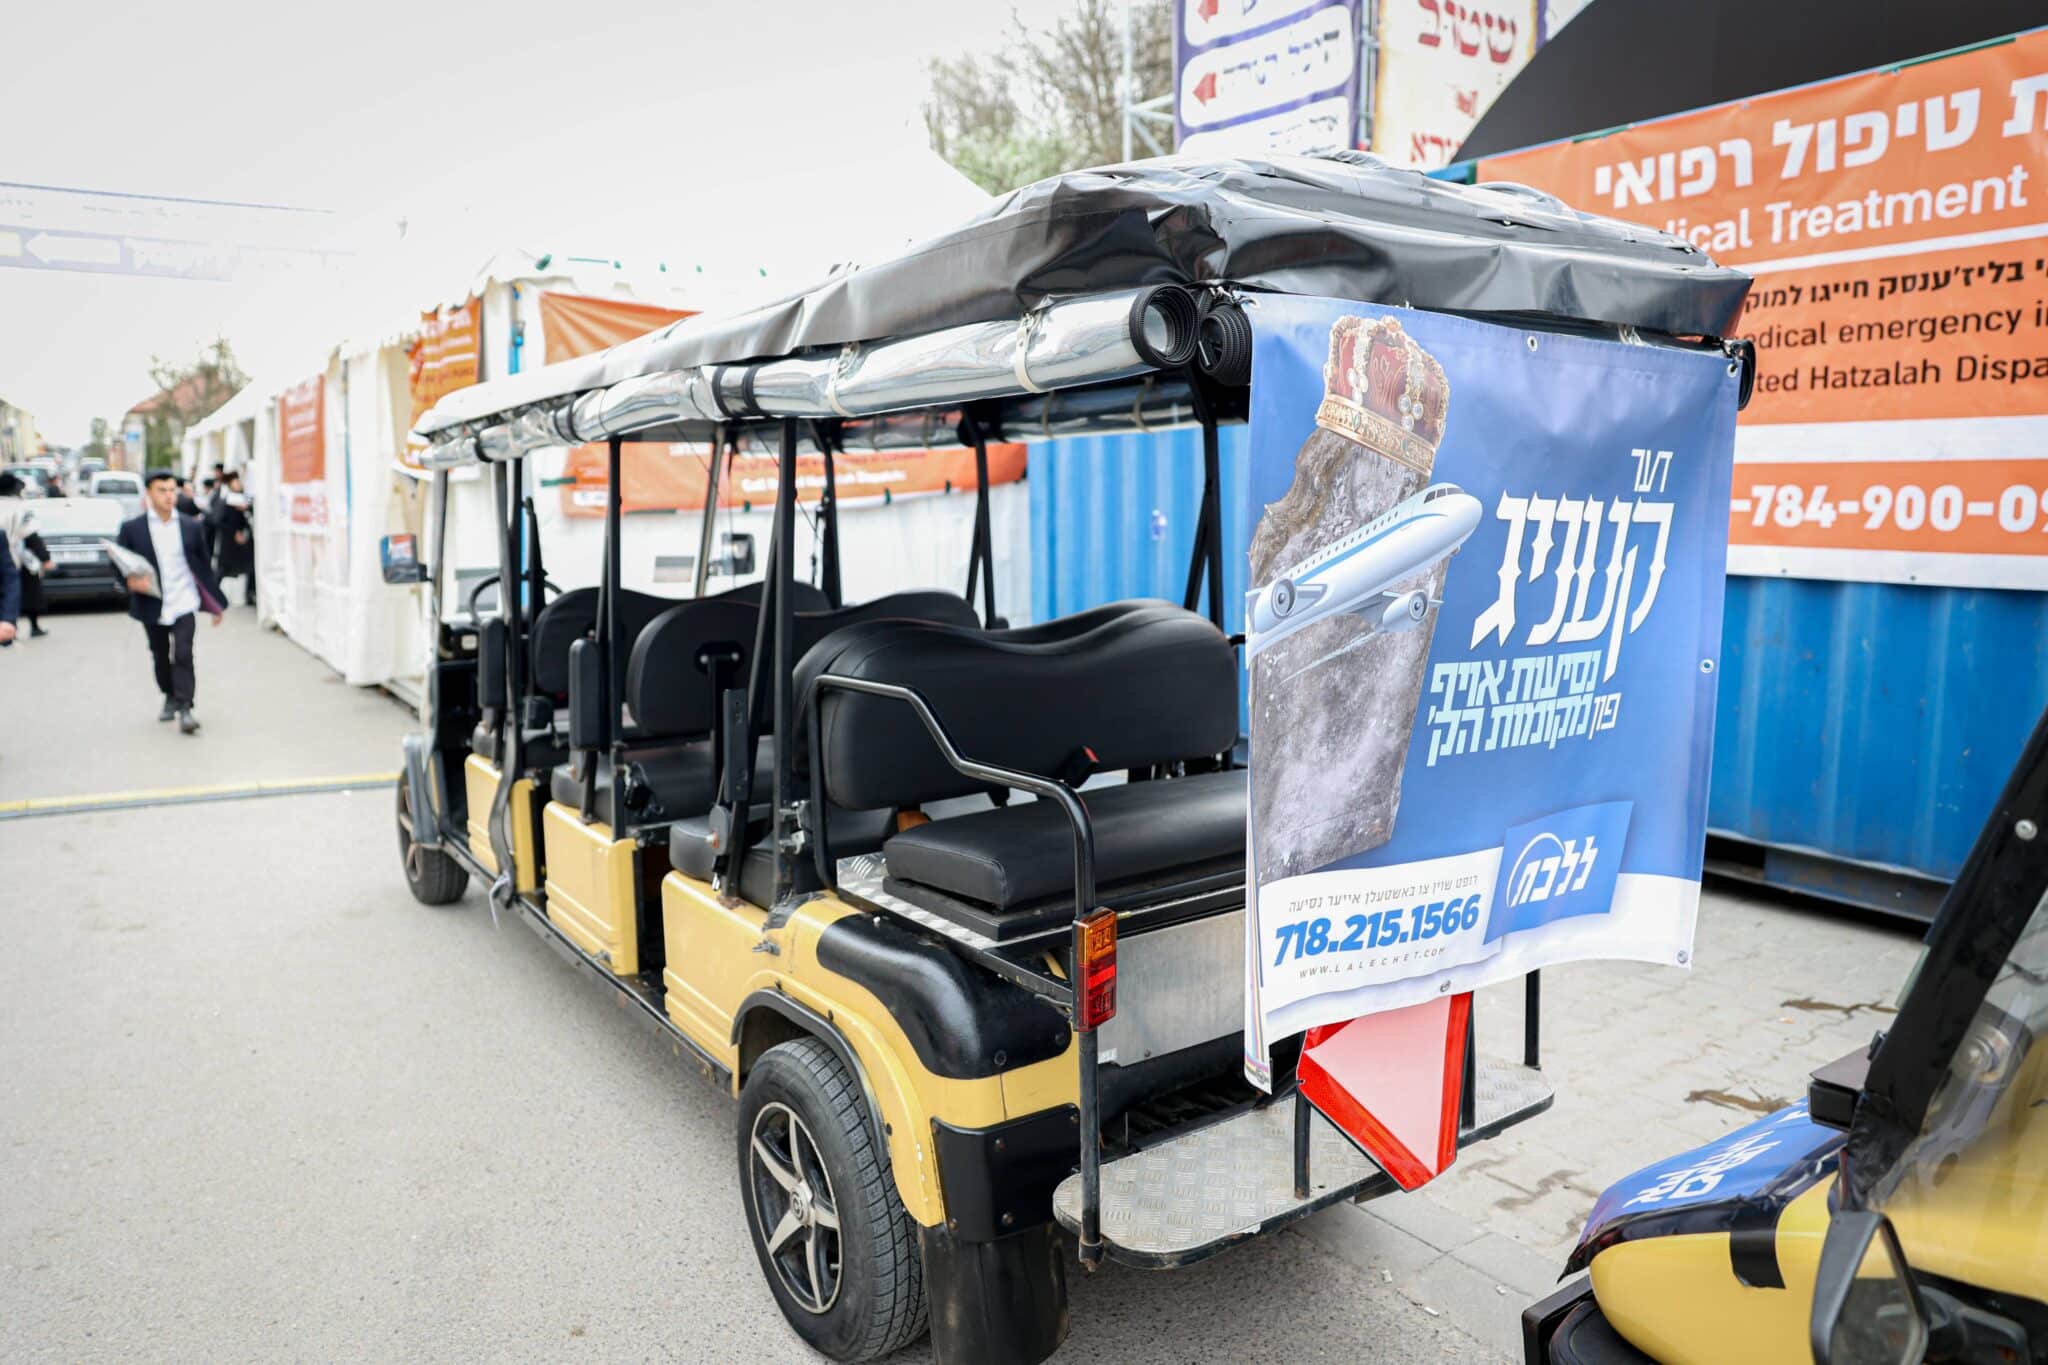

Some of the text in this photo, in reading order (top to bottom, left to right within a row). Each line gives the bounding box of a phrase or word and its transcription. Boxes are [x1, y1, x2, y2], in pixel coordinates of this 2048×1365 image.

[1773, 87, 1981, 180] טיפול
[1595, 138, 1753, 209] רפואי
[1665, 164, 2029, 252] ical Treatment
[1745, 285, 1802, 314] למוק
[1811, 280, 1869, 303] חייגו
[1744, 321, 1827, 349] dical
[1839, 309, 2022, 343] emergency
[1757, 354, 2048, 393] ted Hatzalah Dispa
[1470, 489, 1675, 684] קעניג
[1430, 650, 1602, 711] נסיעות אויף
[1484, 692, 1593, 750] מקומות
[1588, 692, 1622, 740] פון
[1288, 896, 1323, 912] נסיעה
[1328, 893, 1361, 906] אייער
[1364, 886, 1415, 905] באשטעלן
[1433, 879, 1453, 894] שוין
[1274, 893, 1482, 967] 718.215.1566
